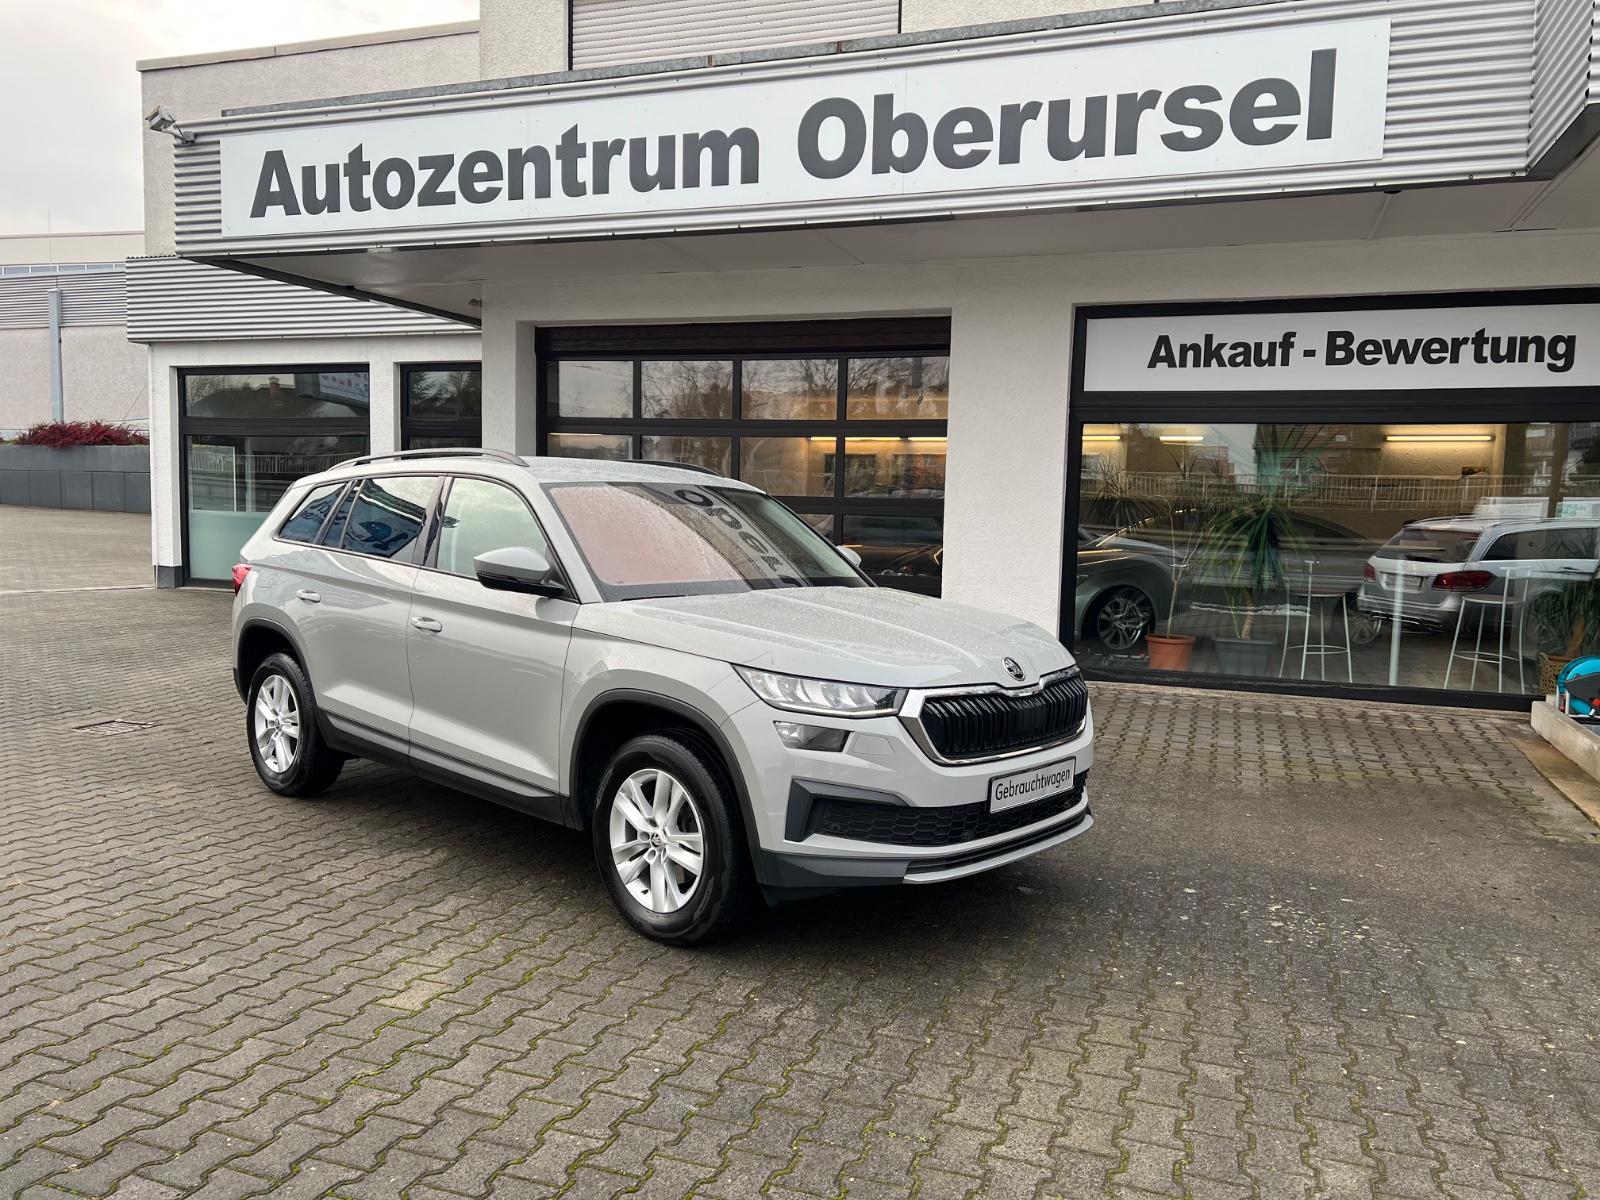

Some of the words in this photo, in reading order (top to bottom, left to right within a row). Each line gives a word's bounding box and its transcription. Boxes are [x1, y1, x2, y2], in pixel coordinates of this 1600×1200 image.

[249, 123, 761, 220] Autozentrum
[797, 48, 1338, 176] Oberursel
[1147, 331, 1298, 369] Ankauf
[1324, 328, 1577, 374] Bewertung
[994, 768, 1071, 801] Gebrauchtwagen
